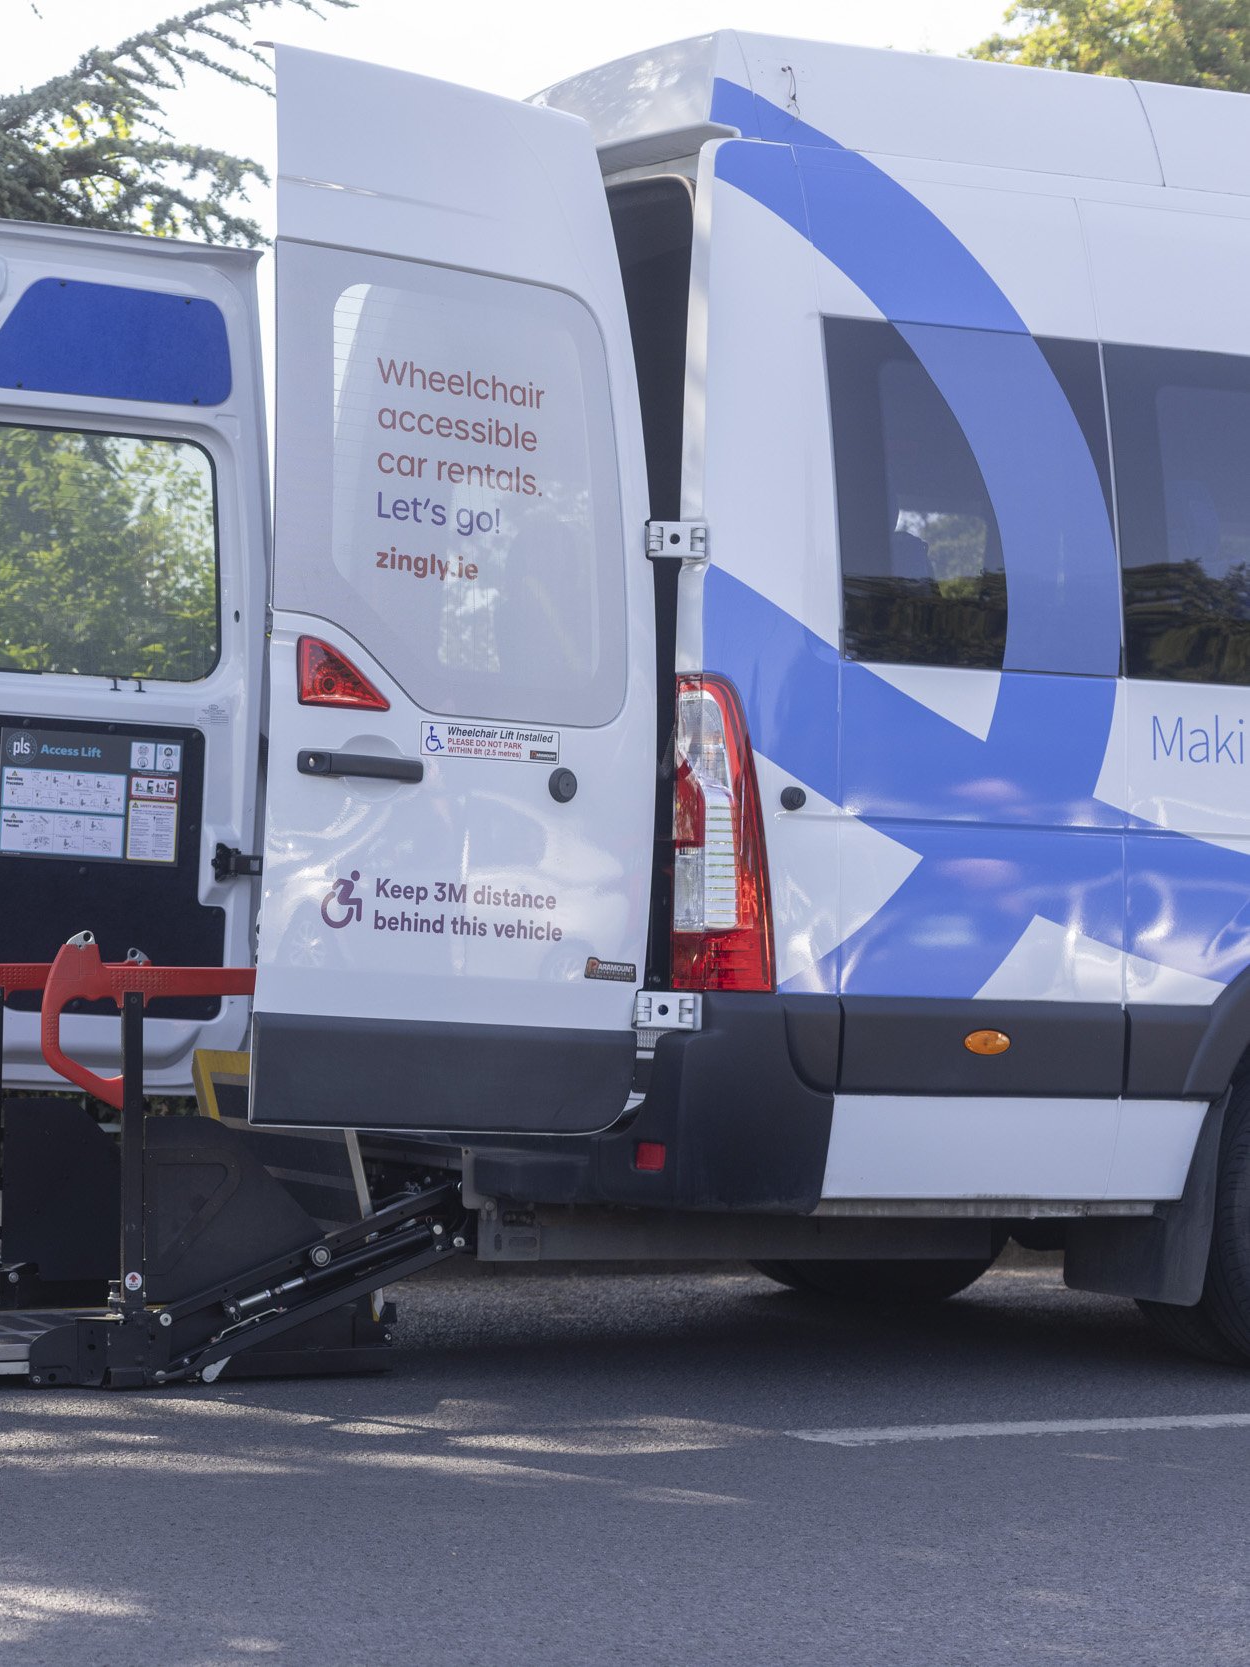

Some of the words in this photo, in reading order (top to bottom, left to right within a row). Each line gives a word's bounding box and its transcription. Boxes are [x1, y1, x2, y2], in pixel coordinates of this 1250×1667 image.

[376, 356, 546, 410] Wheelchair
[377, 406, 538, 452] accessible
[377, 451, 428, 479] car
[437, 458, 544, 498] rentals.
[376, 490, 447, 527] Let's
[456, 507, 502, 537] go!
[375, 546, 479, 582] zingly.ie
[13, 737, 31, 756] pls
[40, 743, 79, 758] Access
[81, 746, 102, 758] Lift
[447, 725, 499, 739] Wheelchair
[499, 730, 515, 741] Lift
[515, 731, 554, 743] Installed
[447, 737, 475, 747] PLEASE
[475, 739, 487, 747] DO
[487, 740, 502, 749] NOT
[503, 742, 523, 750] PARK
[1152, 714, 1245, 765] Maki
[447, 746, 473, 755] WITHIN
[473, 747, 483, 756] 8ft
[484, 748, 497, 757] (2.5
[497, 750, 523, 759] metres)
[375, 876, 429, 906] Keep
[433, 881, 468, 905] 3M
[473, 884, 558, 911] distance
[373, 909, 445, 934] behind
[450, 915, 488, 937] this
[493, 920, 564, 942] vehicle
[587, 958, 634, 975] PARAMOUNT
